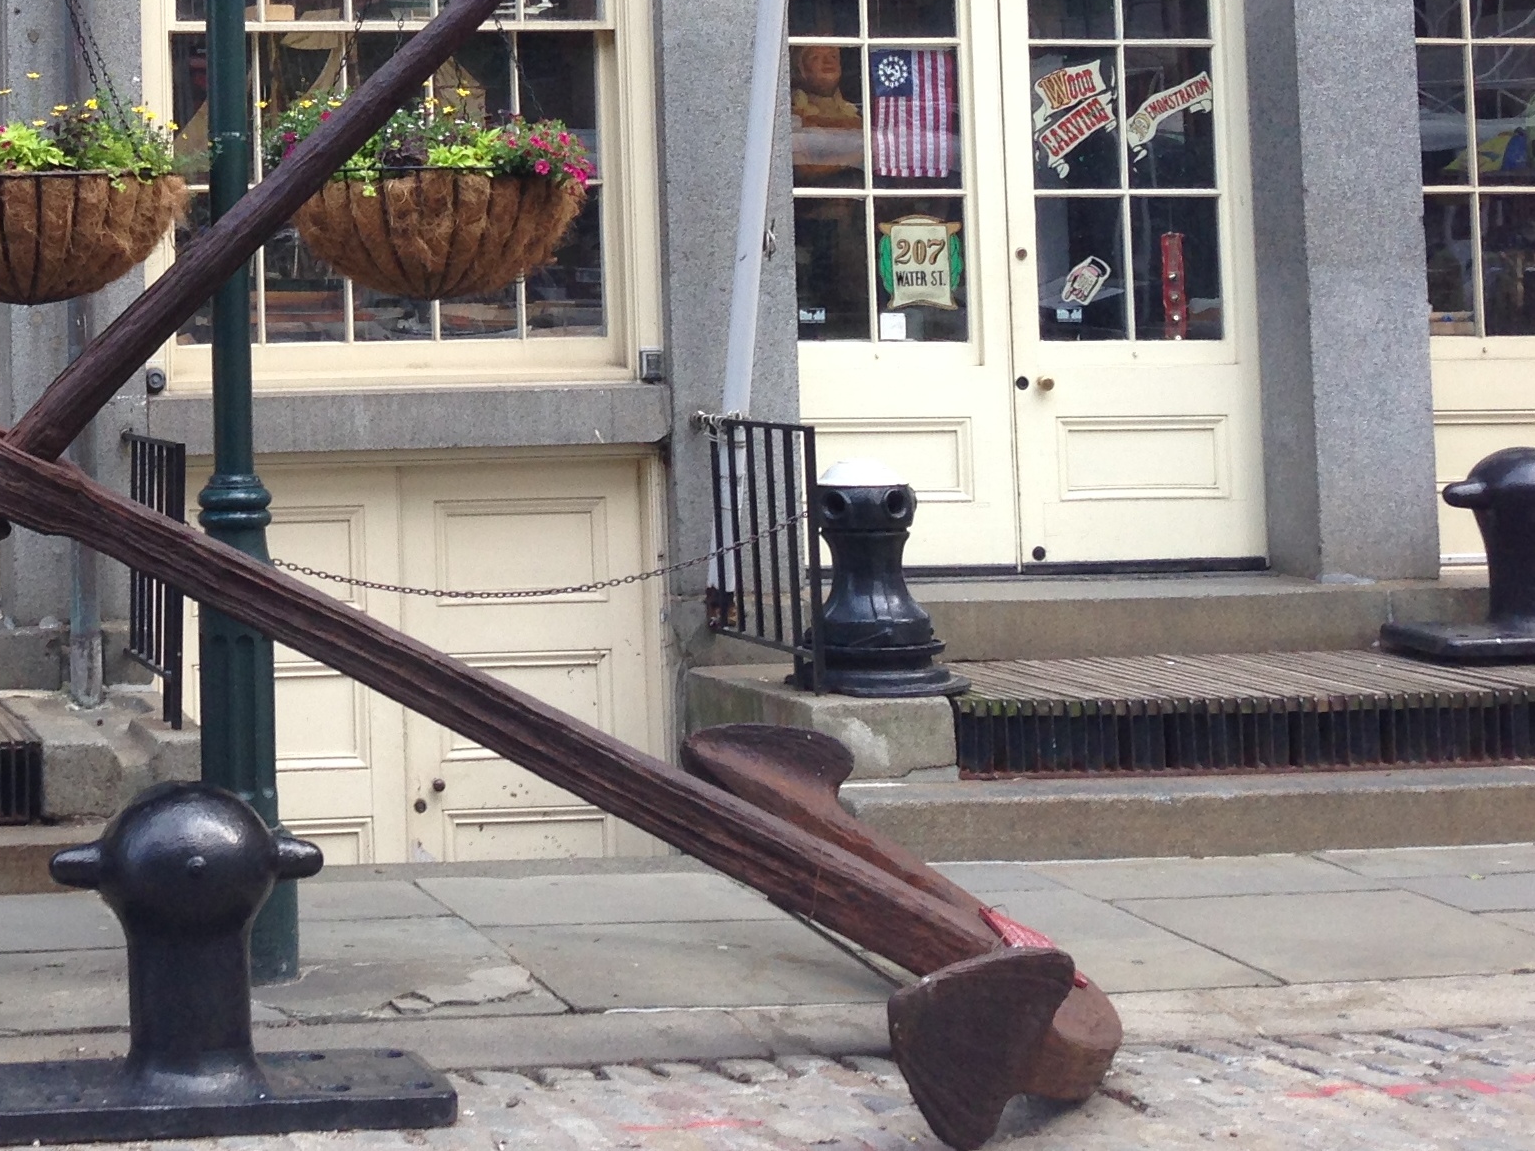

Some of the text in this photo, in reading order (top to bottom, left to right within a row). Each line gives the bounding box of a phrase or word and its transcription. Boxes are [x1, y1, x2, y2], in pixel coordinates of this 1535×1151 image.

[1041, 97, 1110, 157] CARVING
[1129, 77, 1211, 141] DEMONSTRATION
[894, 239, 946, 265] 207
[895, 270, 946, 287] WATER ST.
